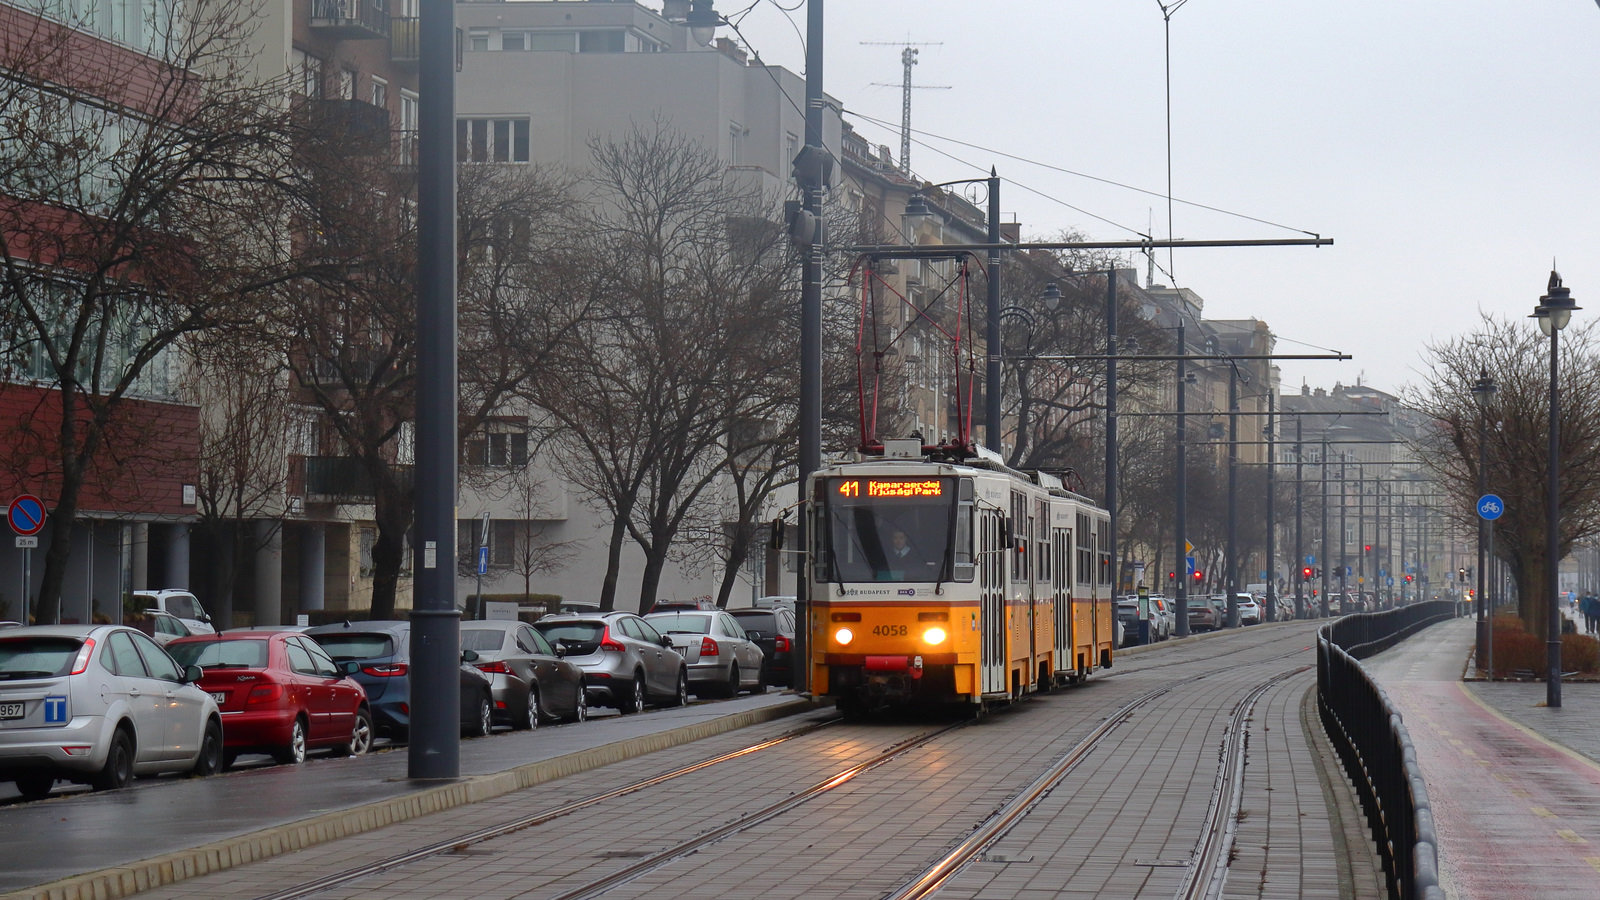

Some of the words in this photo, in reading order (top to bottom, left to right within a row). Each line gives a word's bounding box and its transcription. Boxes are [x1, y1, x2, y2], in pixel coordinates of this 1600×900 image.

[839, 481, 859, 497] 41
[868, 480, 940, 488] Kamaraerdei
[868, 488, 914, 497] Ifjúsági
[19, 538, 27, 546] 25
[872, 625, 908, 636] 4058
[0, 704, 21, 716] 967
